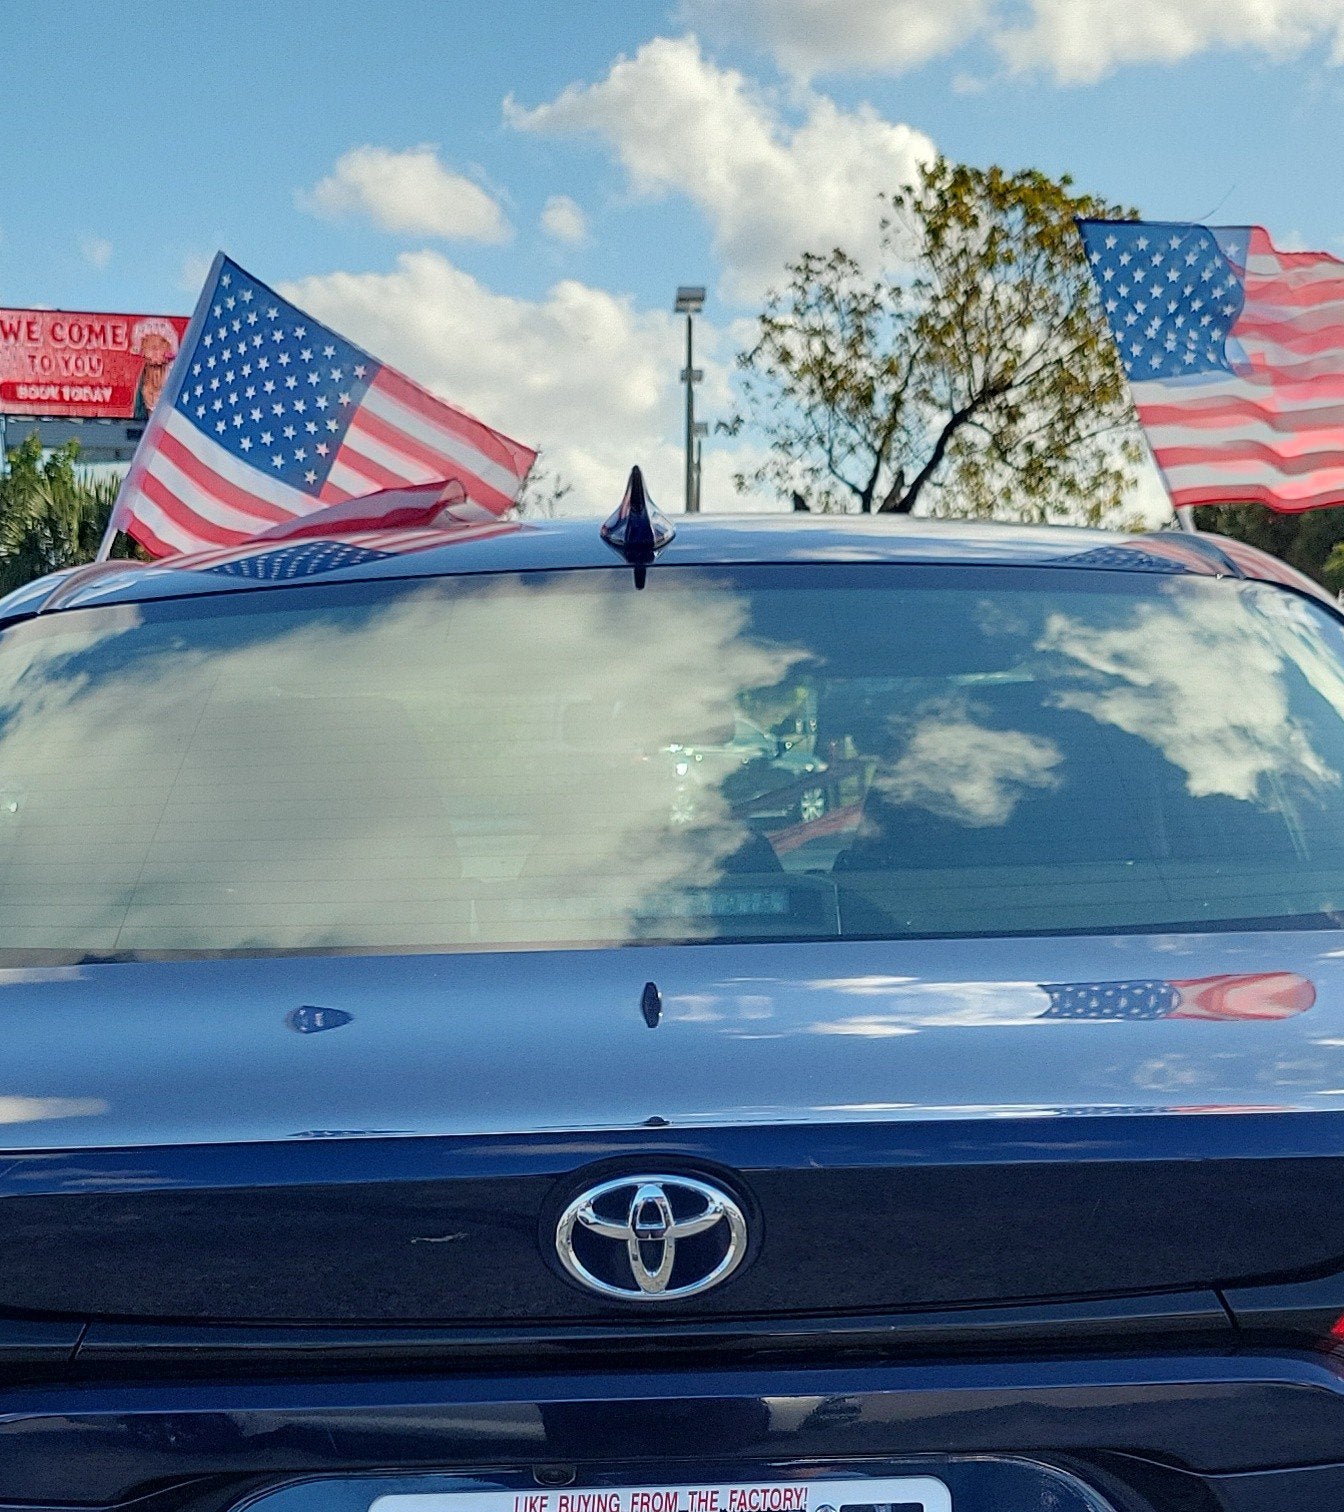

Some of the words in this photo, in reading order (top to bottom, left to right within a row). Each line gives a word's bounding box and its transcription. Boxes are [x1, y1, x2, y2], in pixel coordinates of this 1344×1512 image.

[0, 319, 41, 344] WE
[50, 321, 125, 347] COME
[27, 353, 53, 373] TO
[60, 354, 103, 375] YOU
[61, 385, 113, 402] TODAY
[688, 1490, 720, 1512] THE
[727, 1487, 809, 1512] FACTORY!
